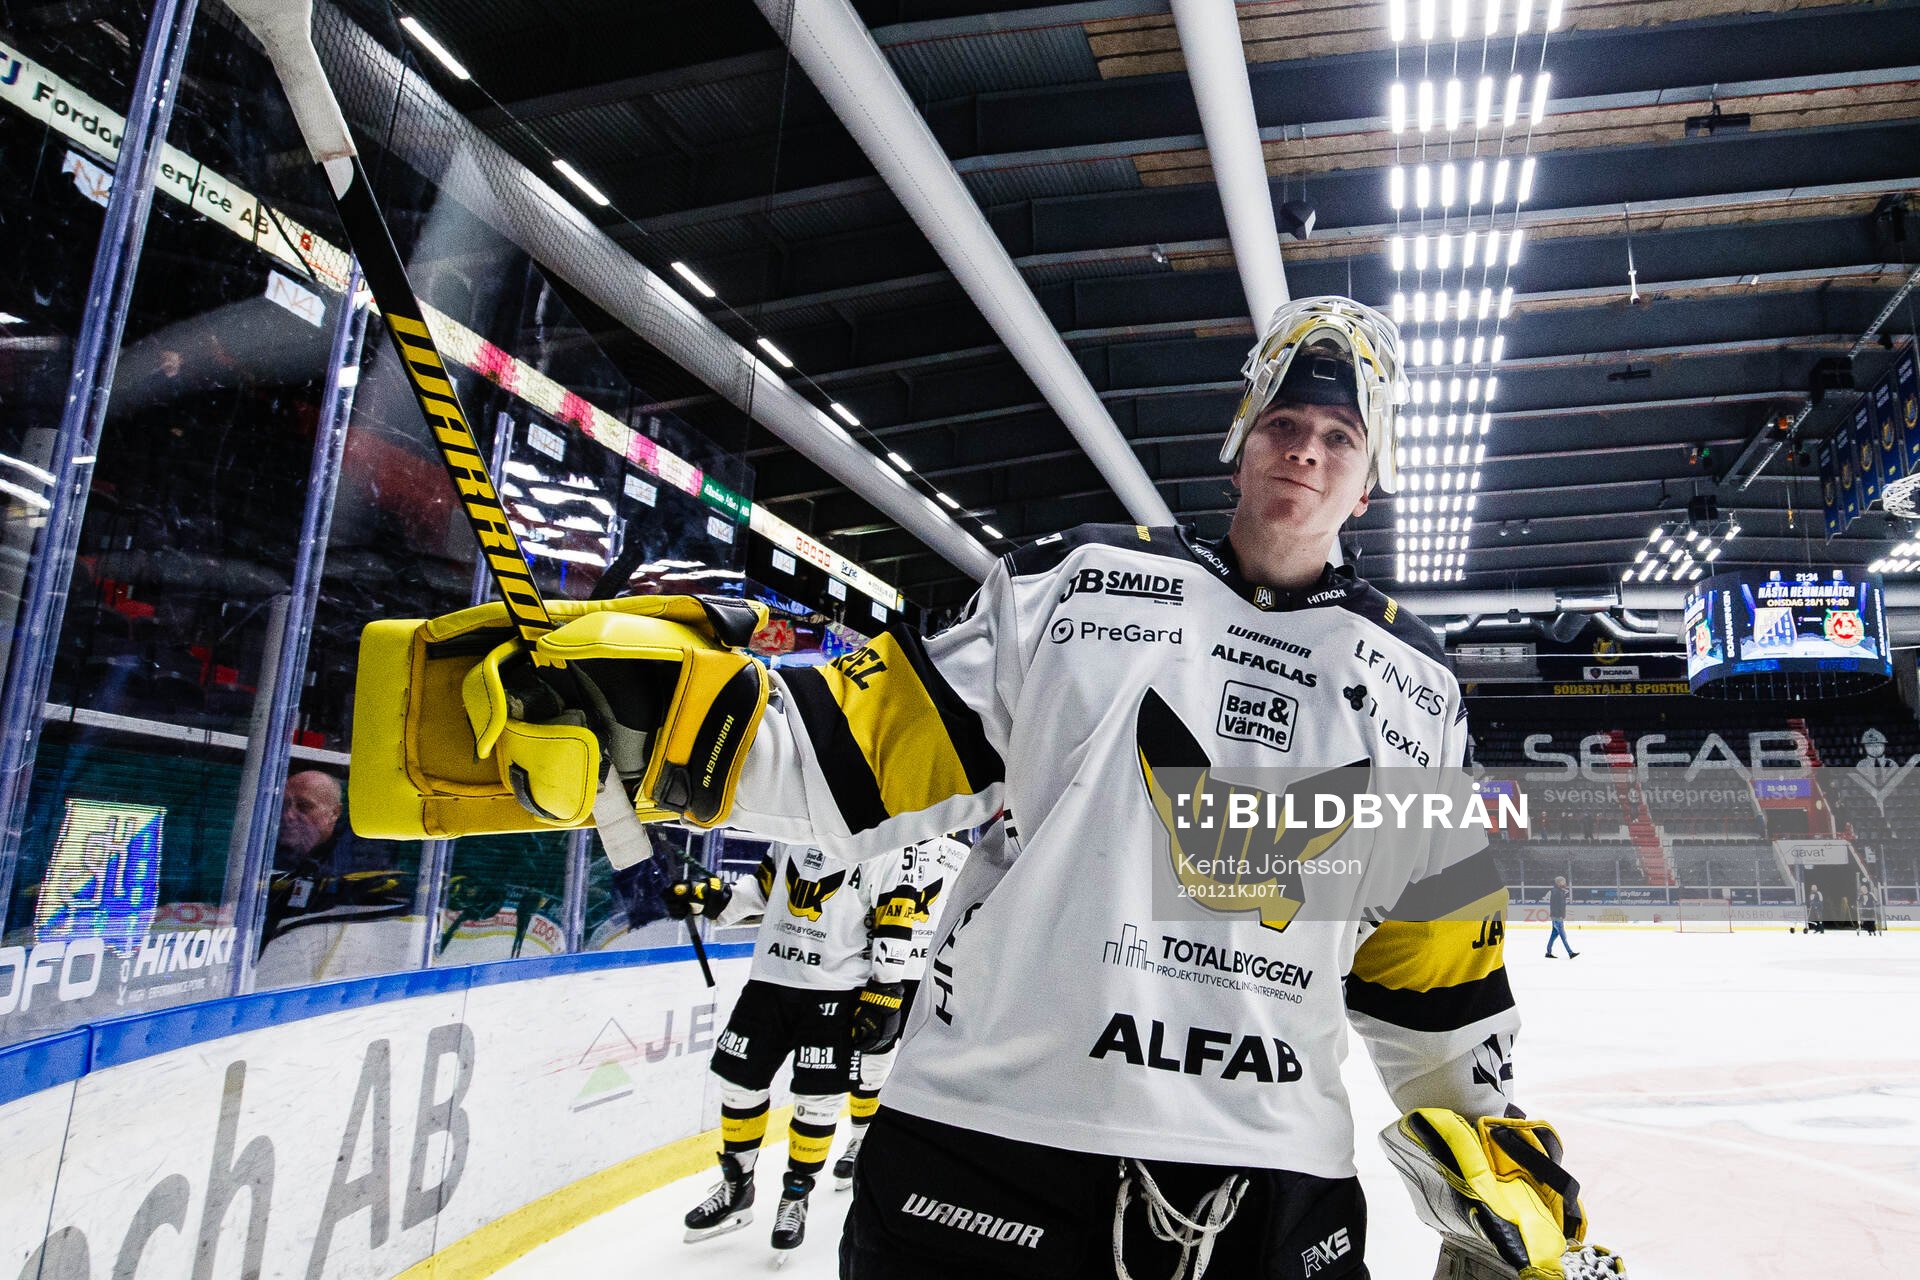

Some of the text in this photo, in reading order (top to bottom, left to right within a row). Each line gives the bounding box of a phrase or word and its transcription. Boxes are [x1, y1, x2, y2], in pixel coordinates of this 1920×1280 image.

[239, 207, 269, 235] AB
[1191, 543, 1230, 576] HITACHI
[1105, 570, 1184, 595] SMIDE
[1307, 588, 1347, 605] HITACHI
[1767, 599, 1803, 607] ONSDAG
[1081, 621, 1182, 645] PreGard
[1227, 624, 1312, 659] WARRIOR
[1211, 644, 1317, 688] ALFAGLAS
[1381, 662, 1446, 716] INVES
[1226, 694, 1290, 727] Bad &
[1224, 714, 1287, 745] Värme
[1524, 730, 1813, 783] SEFAB
[768, 942, 821, 967] ALFAB
[1162, 935, 1313, 989] TOTALBYGGEN
[1088, 1012, 1304, 1084] ALFAB
[306, 1023, 476, 1280] AB
[901, 1192, 1045, 1249] WARRIOR
